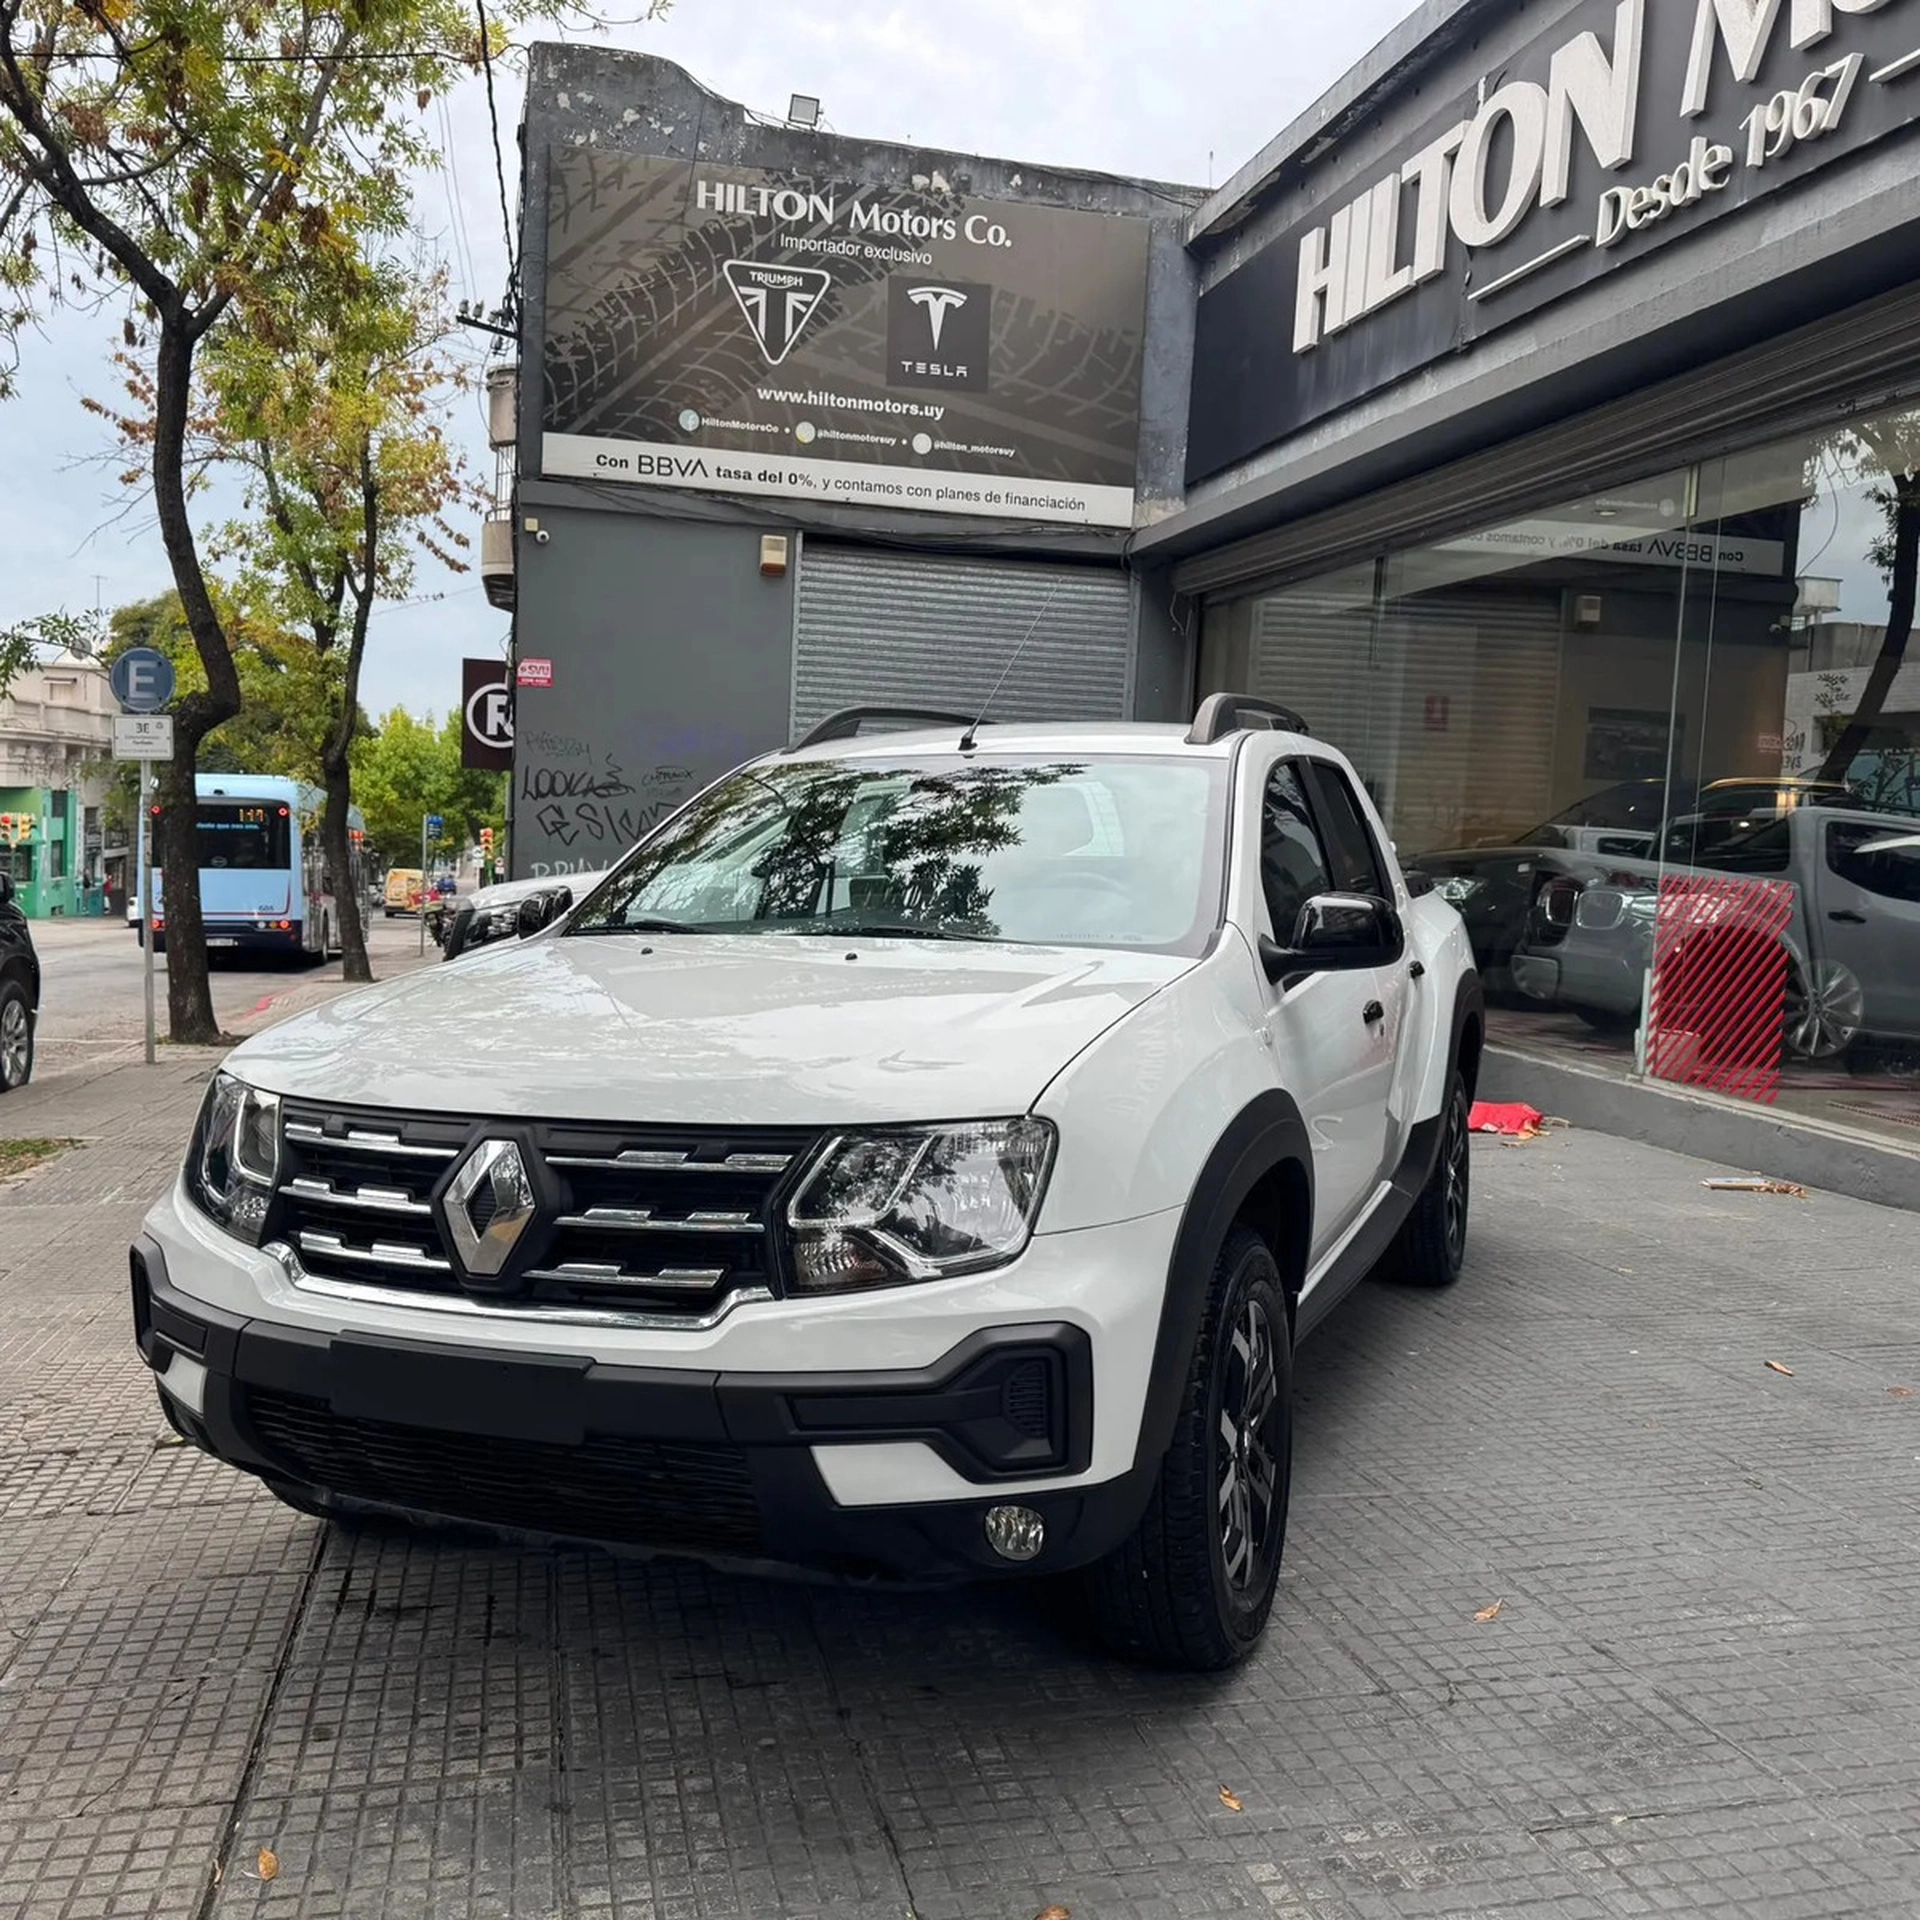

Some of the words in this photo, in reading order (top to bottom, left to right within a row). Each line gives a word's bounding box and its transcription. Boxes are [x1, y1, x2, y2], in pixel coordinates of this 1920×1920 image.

[1595, 136, 1733, 249] Desde
[1738, 52, 1865, 168] 1967
[1293, 0, 1645, 354] HILTON
[696, 180, 834, 225] HILTON
[849, 200, 956, 240] Motors
[963, 215, 1012, 248] Co.
[780, 233, 862, 258] Importador
[864, 244, 932, 265] exclusivo
[750, 270, 803, 287] TRIUMPH
[901, 361, 968, 377] TESLA
[757, 387, 945, 420] www.hiltonmotors.uy
[701, 417, 779, 434] HiltonMotorsCo
[595, 453, 629, 469] Con
[637, 454, 709, 478] BBVA
[716, 466, 752, 481] tasa
[757, 470, 782, 483] del
[822, 477, 830, 490] y
[834, 479, 903, 495] contamos
[906, 485, 932, 497] con
[936, 487, 980, 501] planes
[984, 490, 1001, 504] de
[1005, 492, 1085, 511] financiación
[129, 660, 157, 699] E
